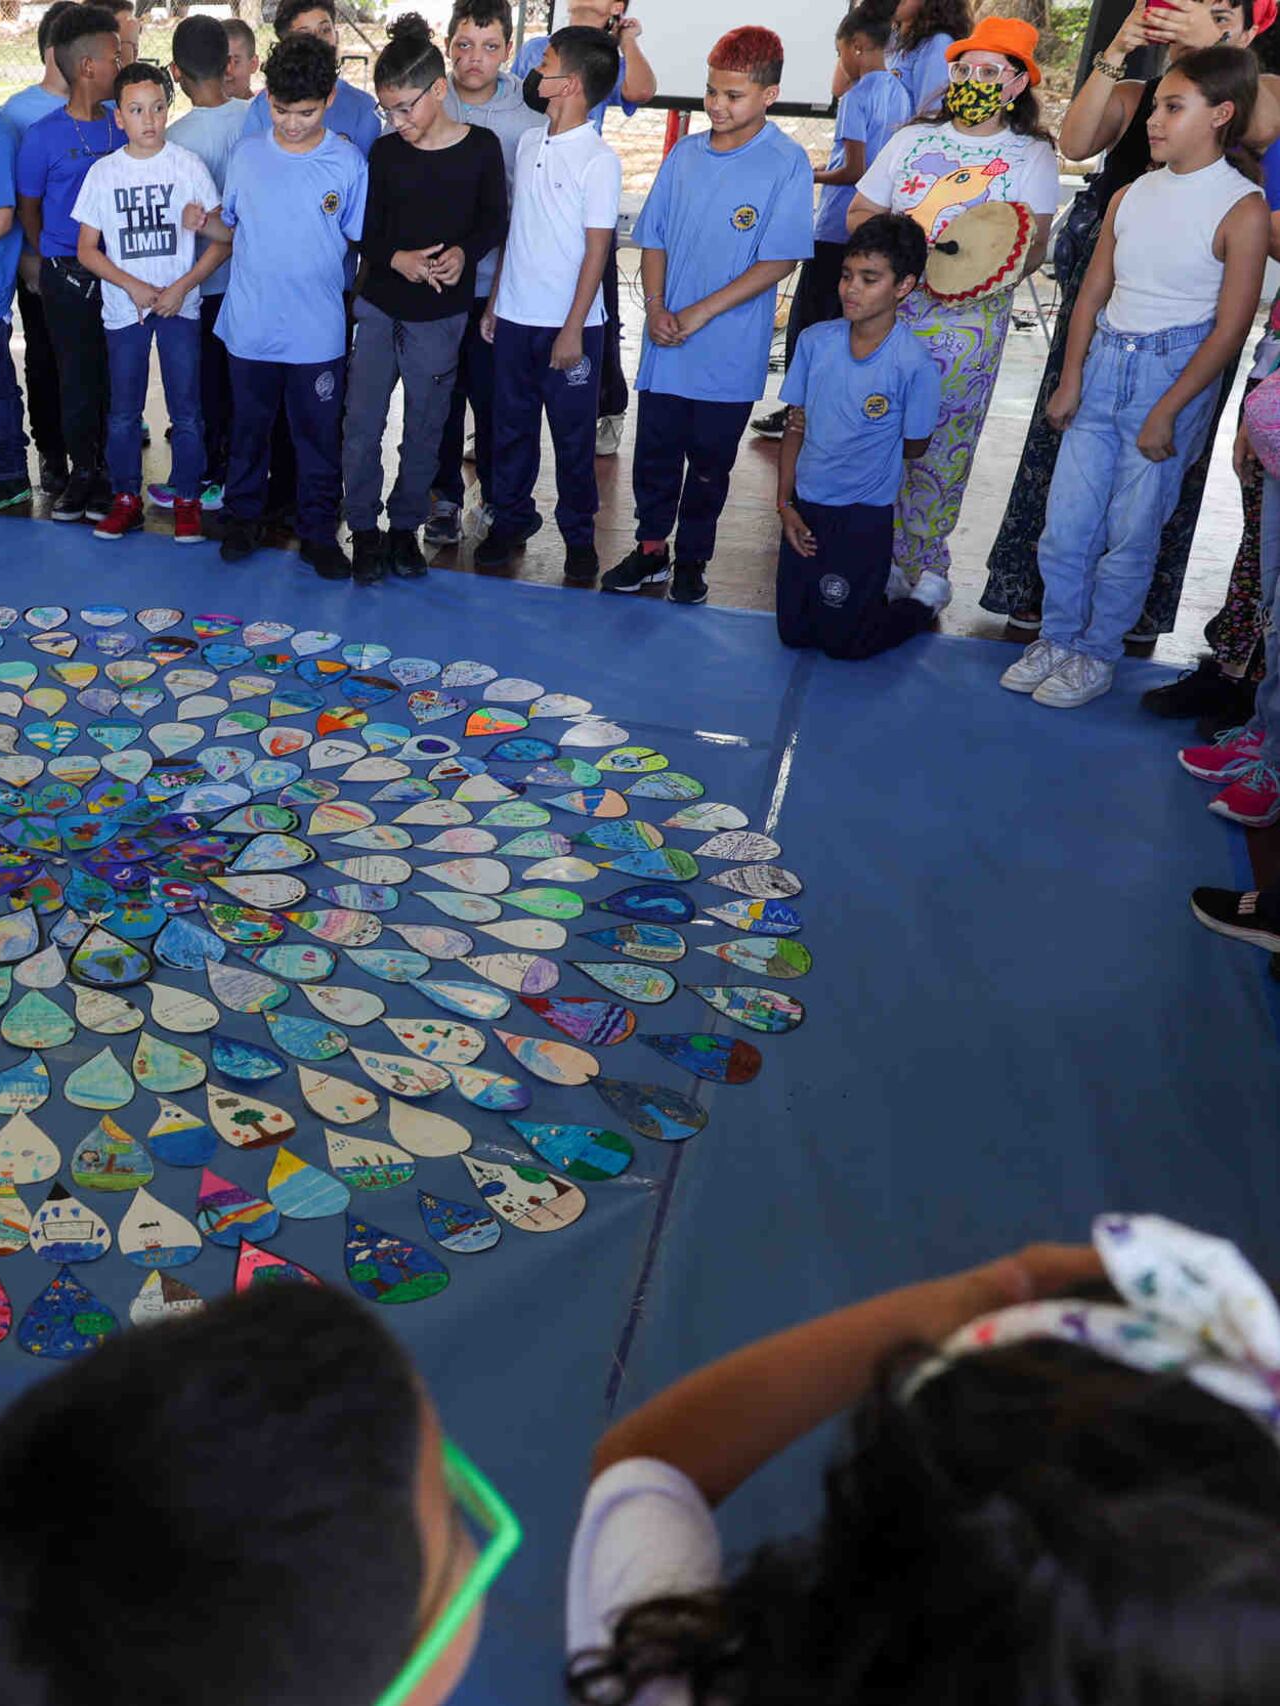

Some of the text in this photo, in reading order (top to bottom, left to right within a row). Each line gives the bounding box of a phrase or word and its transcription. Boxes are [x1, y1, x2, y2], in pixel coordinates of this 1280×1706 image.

[114, 183, 174, 213] DEFY
[122, 204, 170, 232] THE
[124, 230, 172, 253] LIMIT
